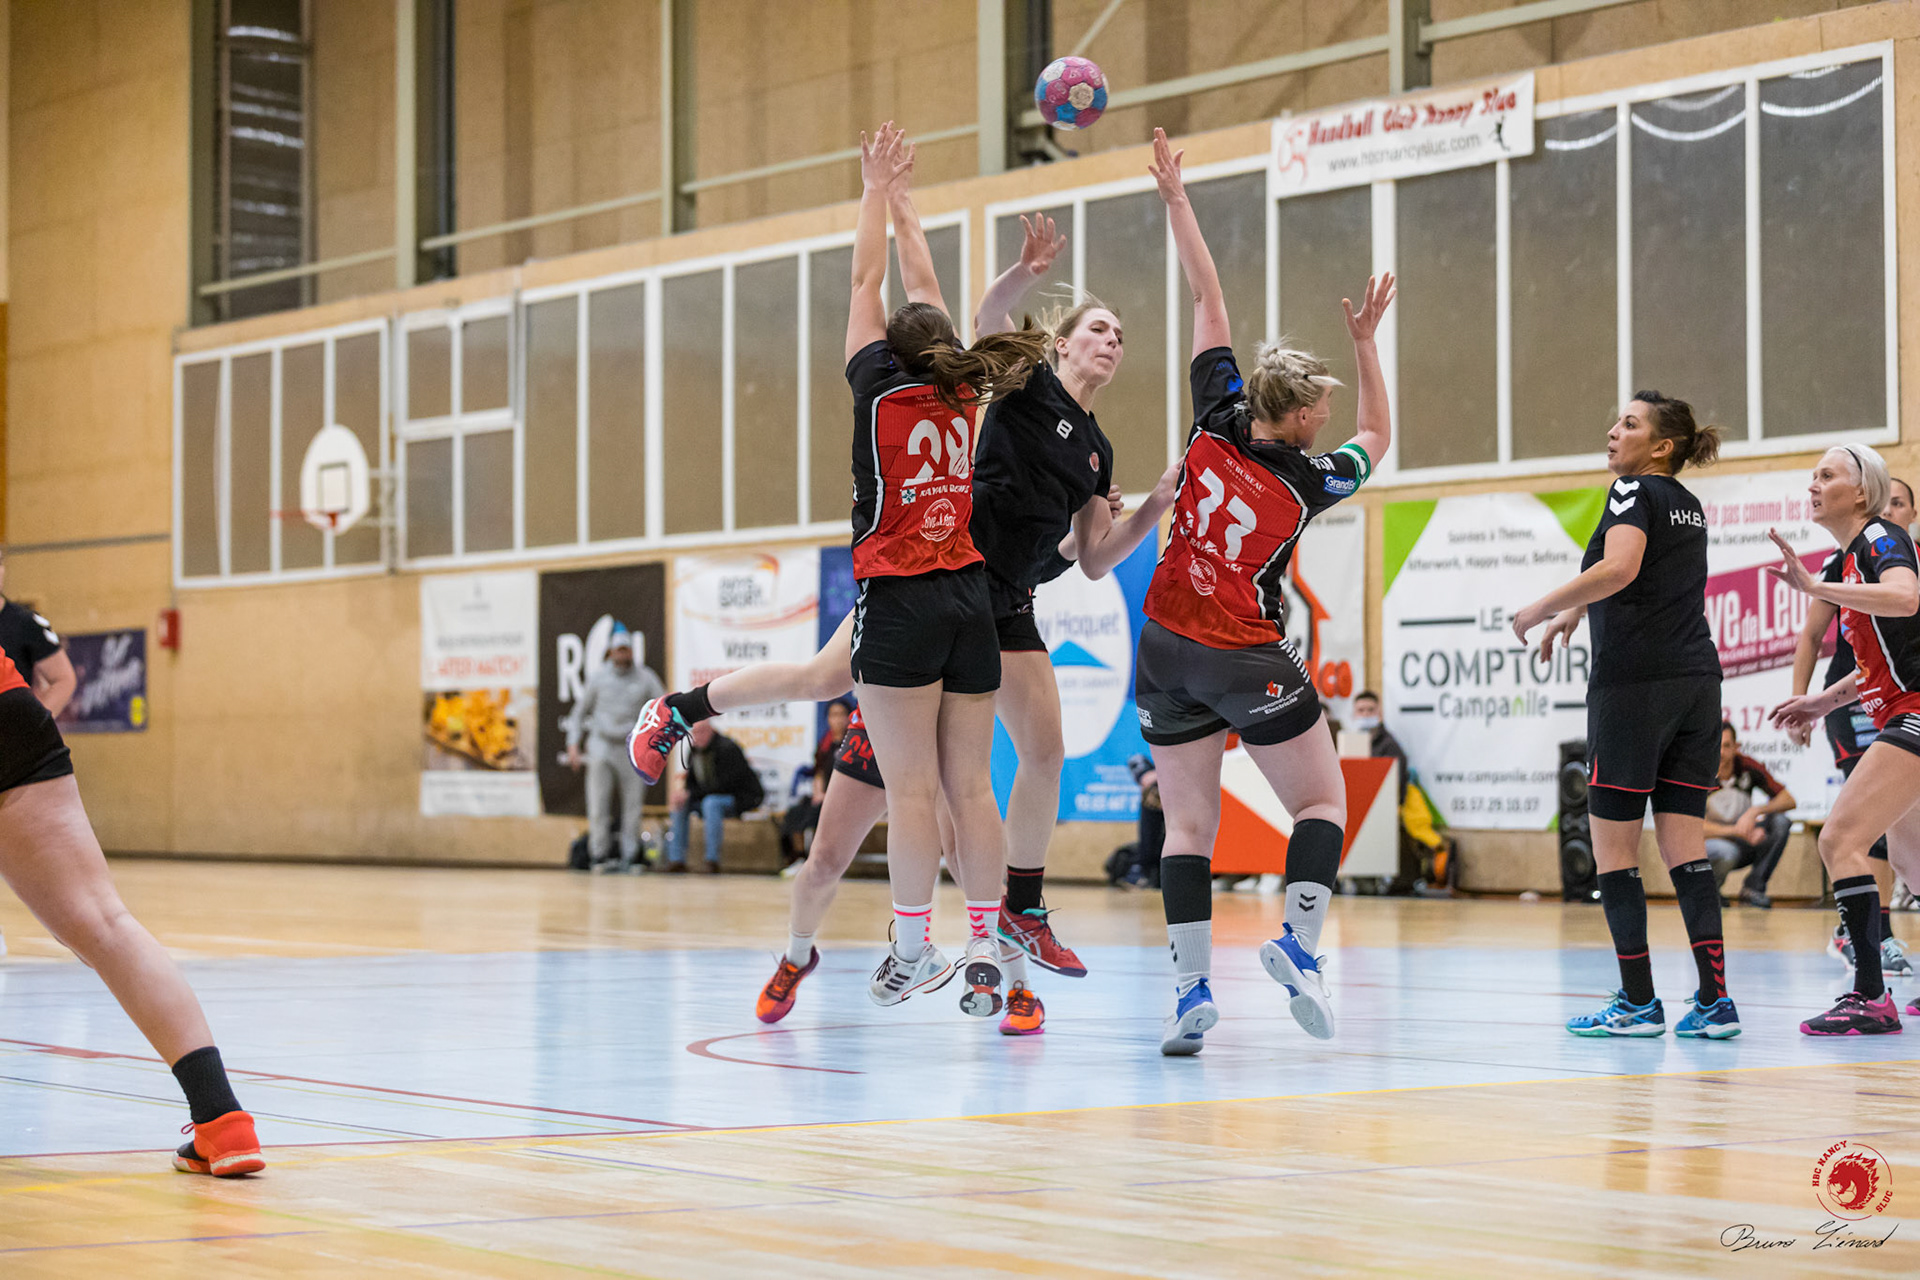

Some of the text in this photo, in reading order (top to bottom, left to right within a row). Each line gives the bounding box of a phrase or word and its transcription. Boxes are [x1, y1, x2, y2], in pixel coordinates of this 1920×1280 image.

[1308, 112, 1373, 146] Handball
[902, 416, 969, 487] 28
[1235, 466, 1266, 493] BUREAU
[1721, 504, 1740, 527] pas
[1743, 501, 1782, 524] comme
[1785, 496, 1801, 520] les
[1466, 555, 1499, 569] Happy
[1056, 611, 1119, 638] Hoquet
[1480, 607, 1504, 632] LE
[1742, 609, 1758, 644] de
[1401, 646, 1588, 688] COMPTOIR
[1438, 693, 1548, 728] Campanile
[1741, 706, 1765, 731] 17
[841, 735, 874, 770] 24
